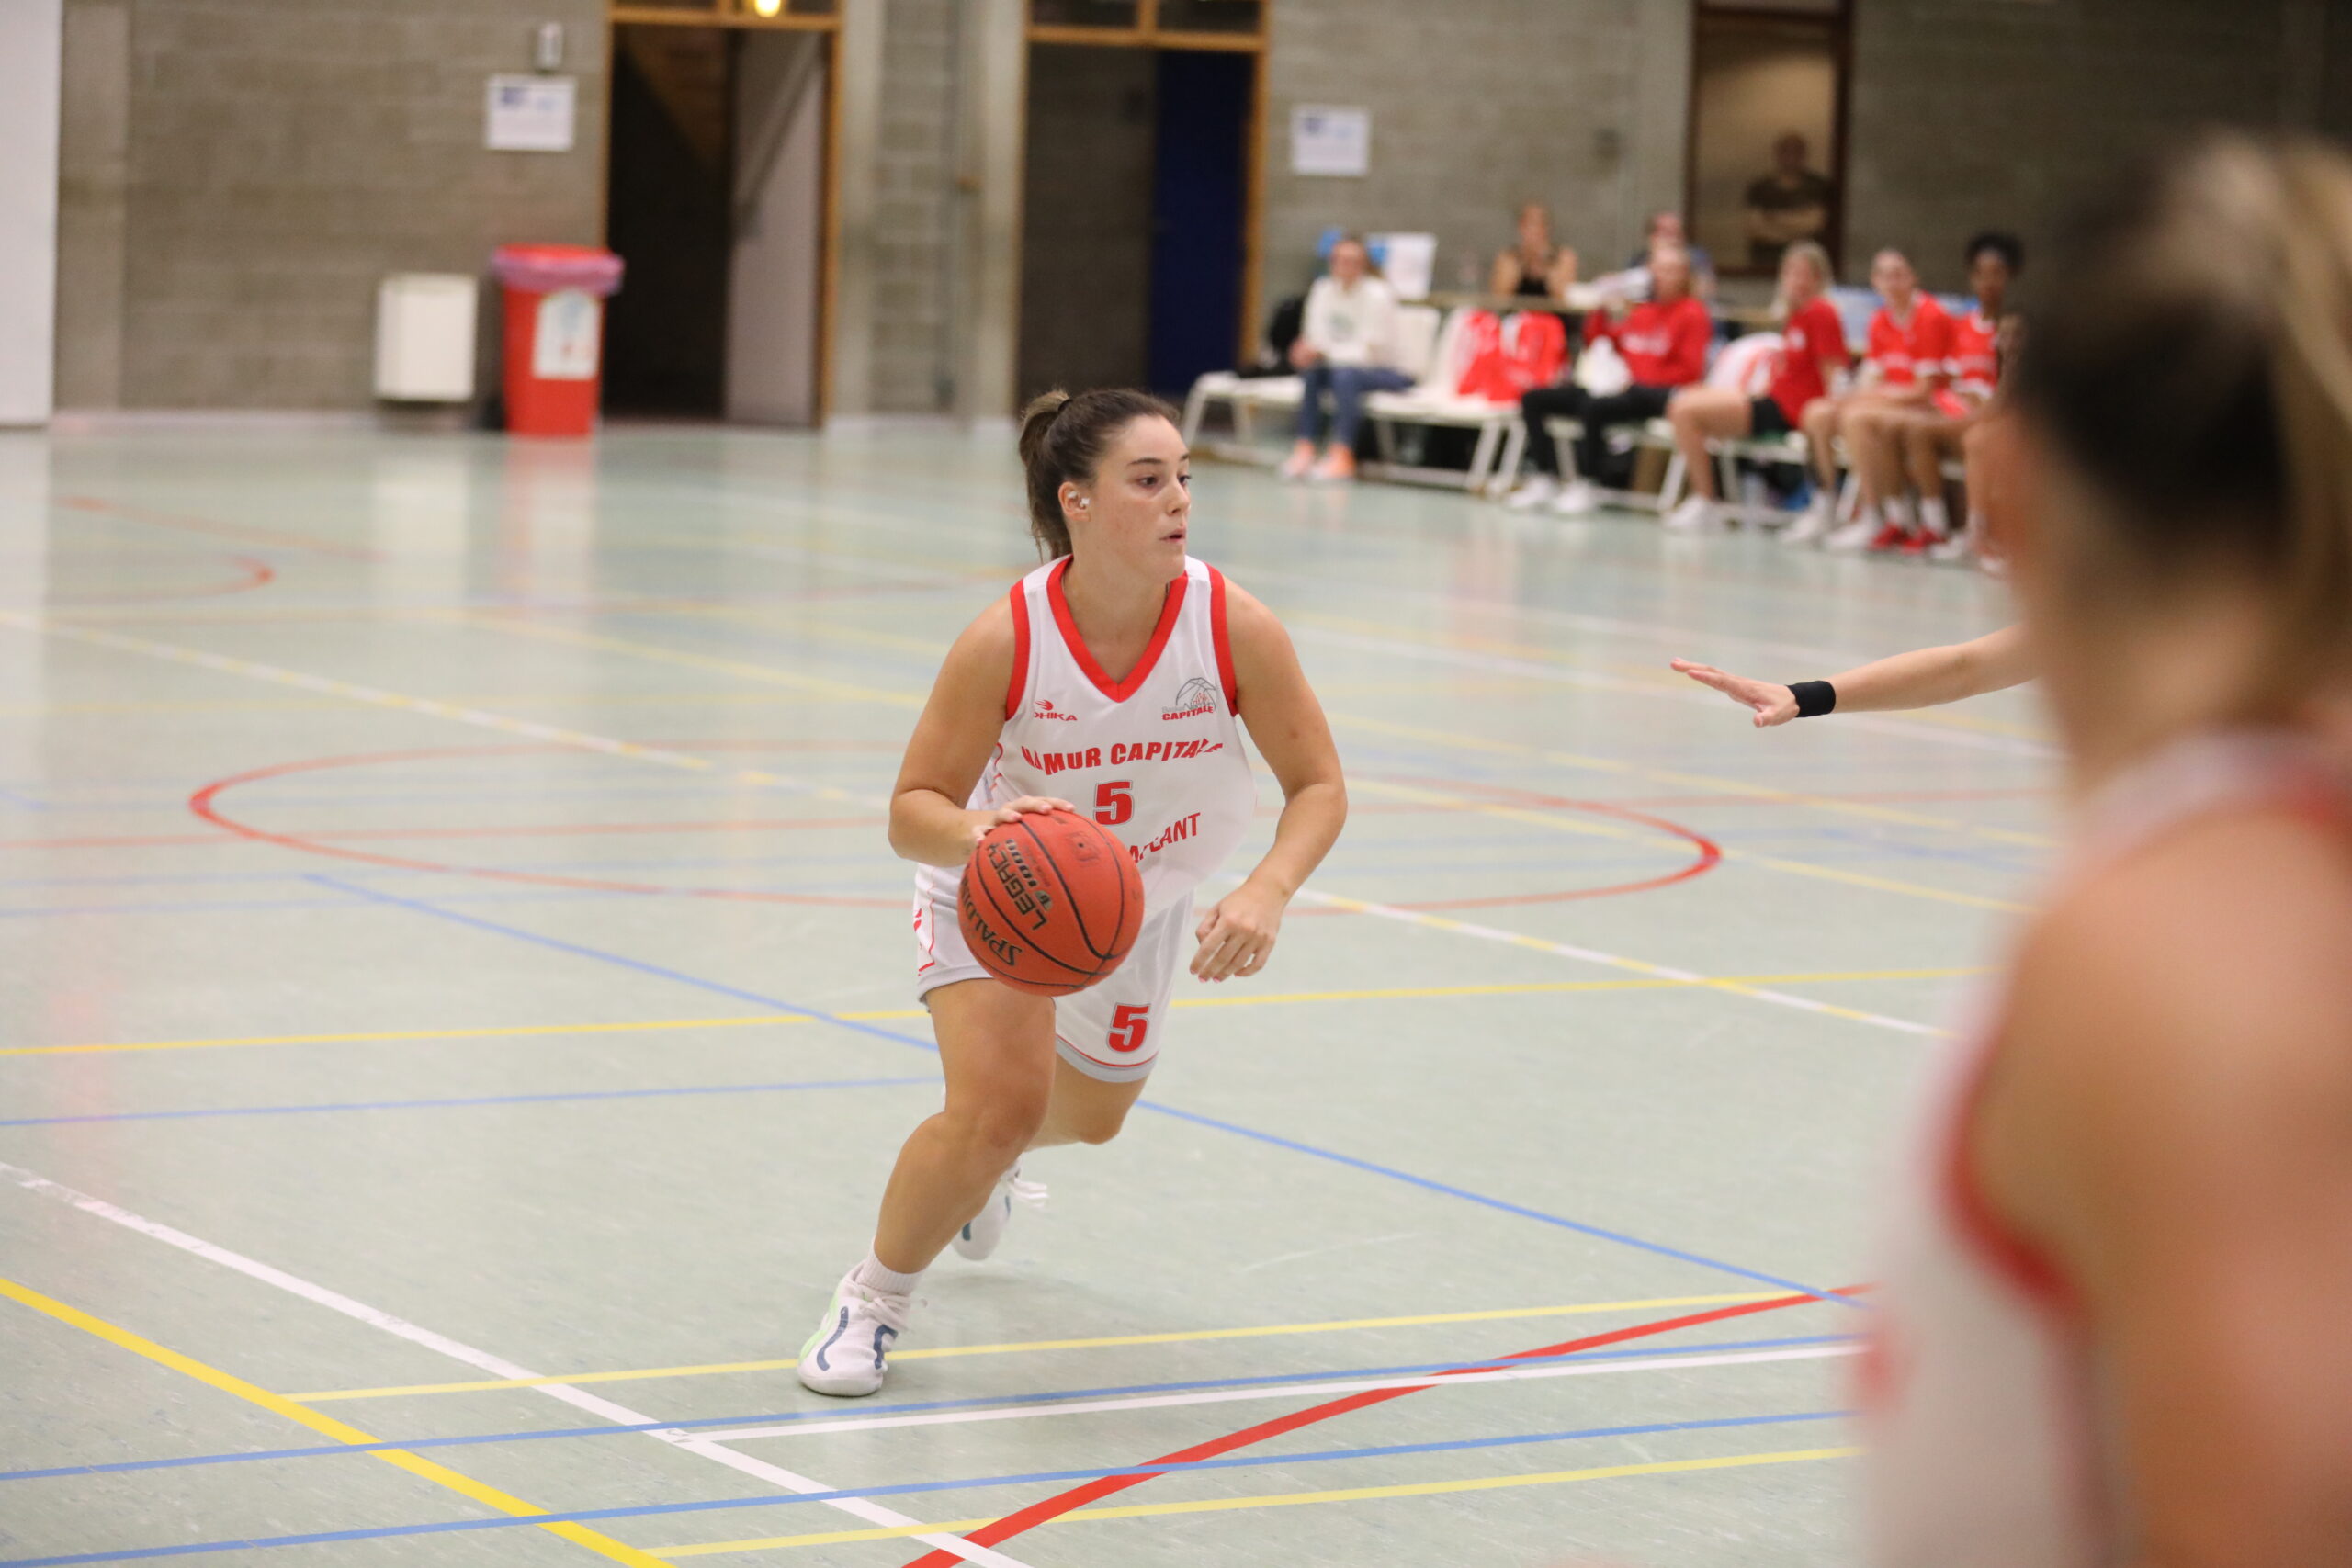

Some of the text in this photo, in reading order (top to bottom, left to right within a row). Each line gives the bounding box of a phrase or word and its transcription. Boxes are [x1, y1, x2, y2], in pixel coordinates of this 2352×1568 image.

[1162, 705, 1214, 721] CAPITALE
[1093, 780, 1135, 826] 5
[986, 842, 1047, 931] LEGACY
[1106, 1001, 1152, 1055] 5
